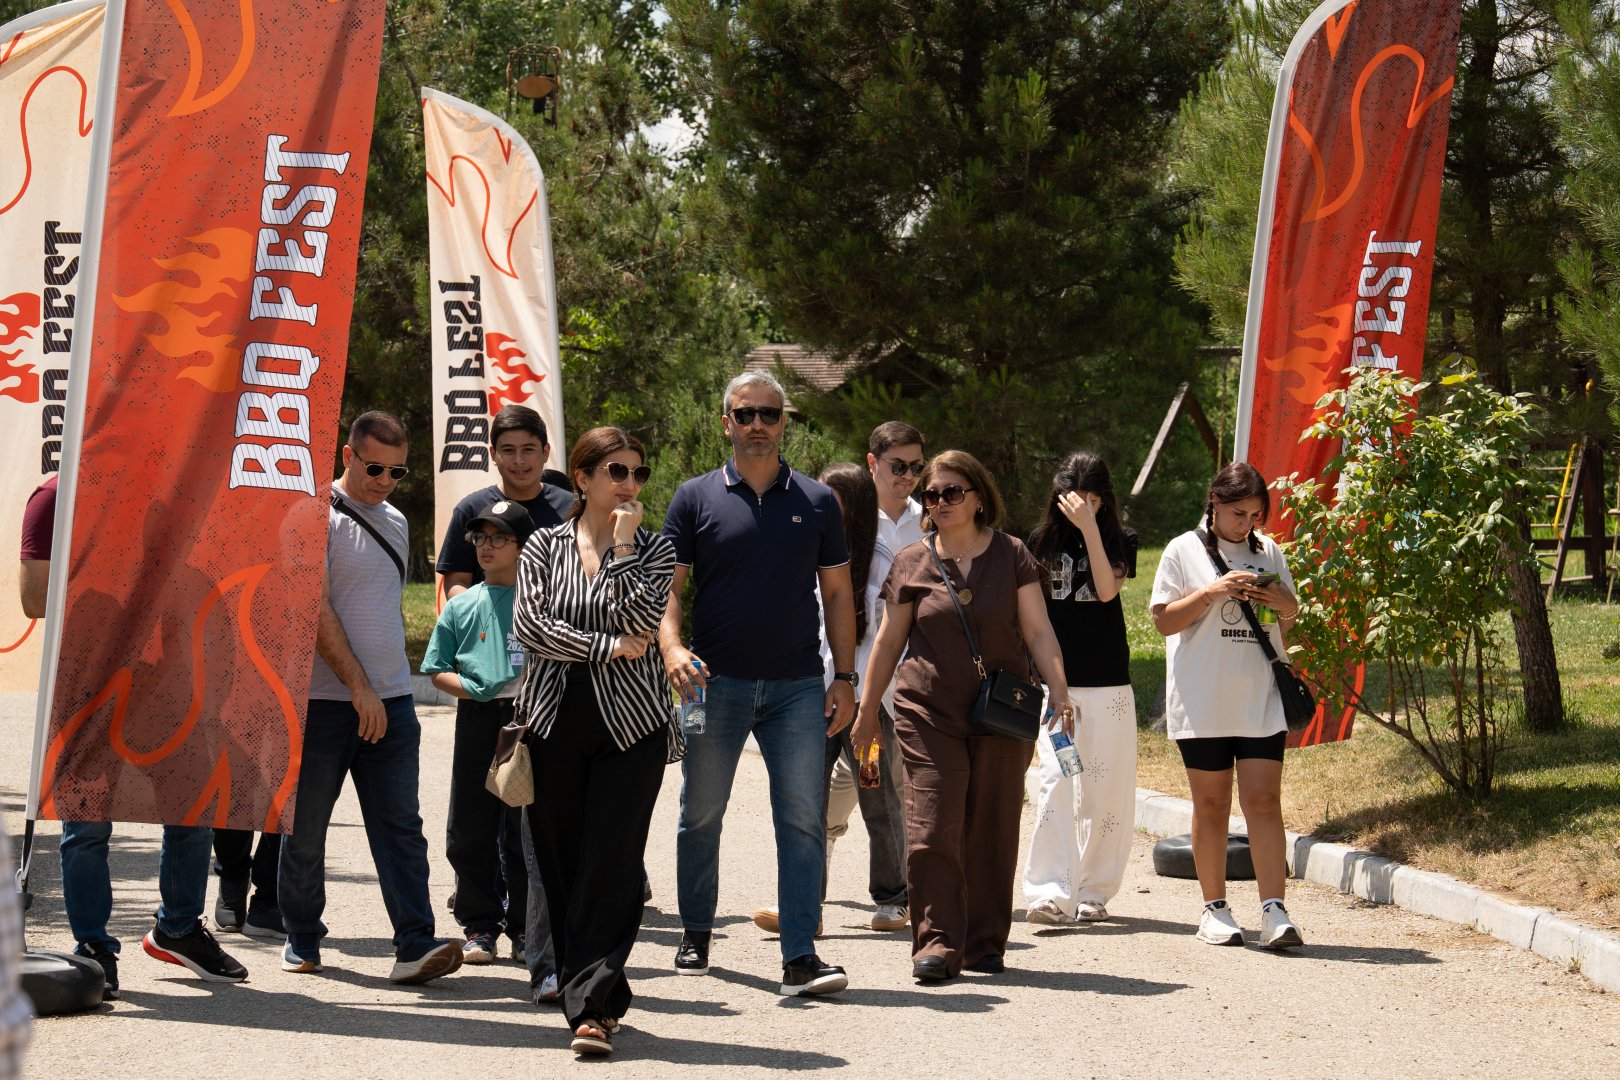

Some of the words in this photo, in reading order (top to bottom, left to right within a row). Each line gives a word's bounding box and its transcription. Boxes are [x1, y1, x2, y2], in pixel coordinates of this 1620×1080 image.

[249, 133, 351, 327] FEST
[1350, 230, 1422, 371] FEST
[228, 341, 320, 497] BBQ
[506, 640, 524, 651] 202
[1221, 629, 1247, 638] BIKE
